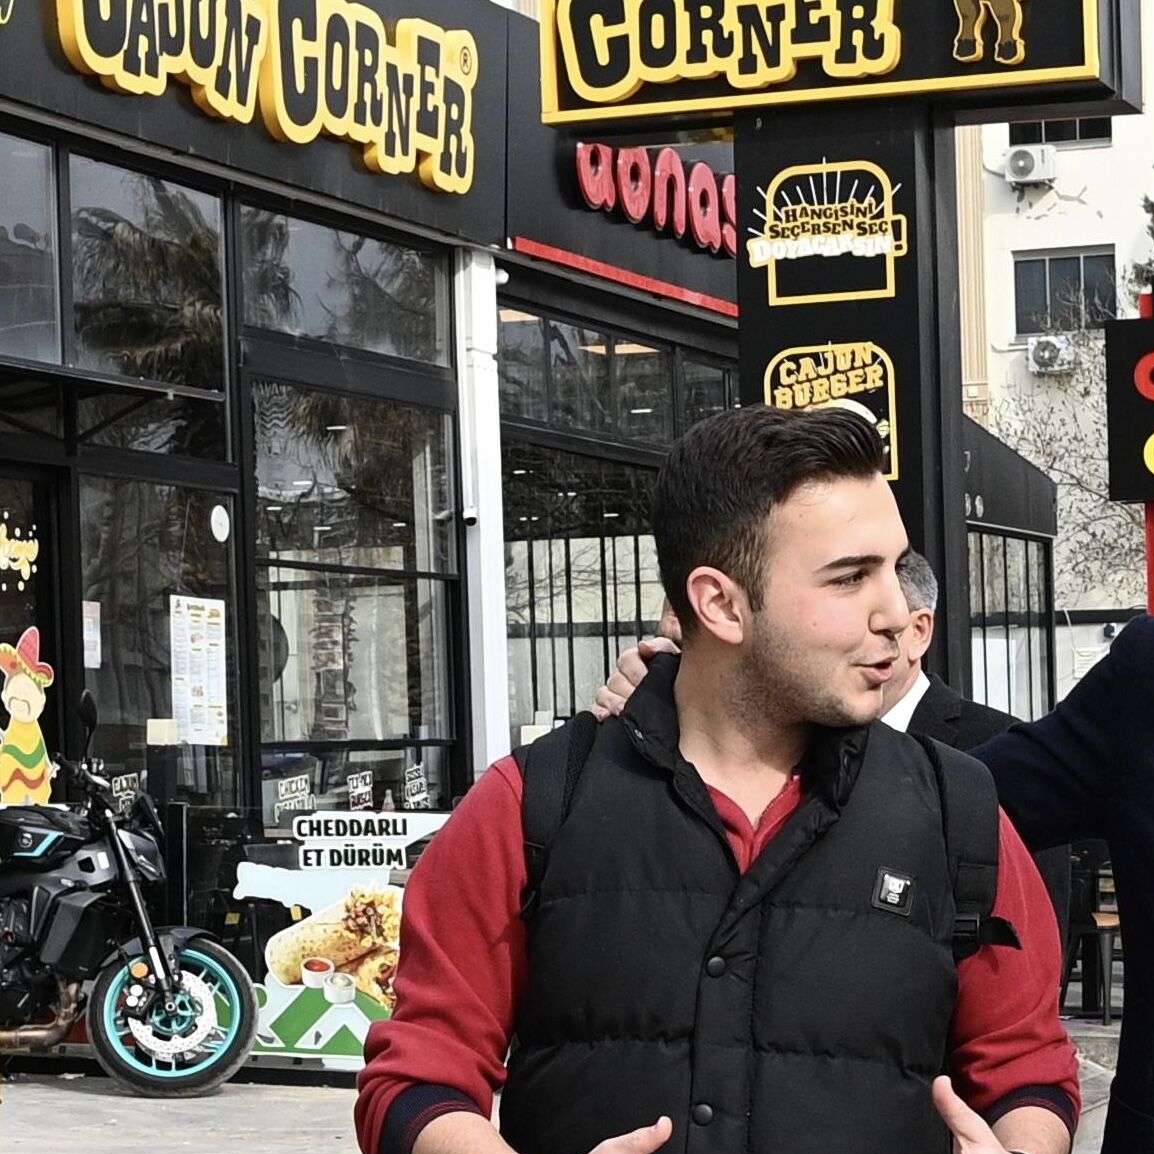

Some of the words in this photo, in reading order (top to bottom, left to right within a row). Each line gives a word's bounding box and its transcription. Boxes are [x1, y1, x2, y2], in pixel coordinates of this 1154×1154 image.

[568, 0, 885, 89] CORNER
[768, 219, 854, 240] SEÇERSEN
[855, 220, 889, 237] SEÇ
[778, 345, 873, 386] CAJUN
[773, 364, 884, 410] BURGER
[296, 818, 408, 837] CHEDDARLI
[303, 848, 325, 867] ET
[329, 843, 404, 867] DÜRÜM
